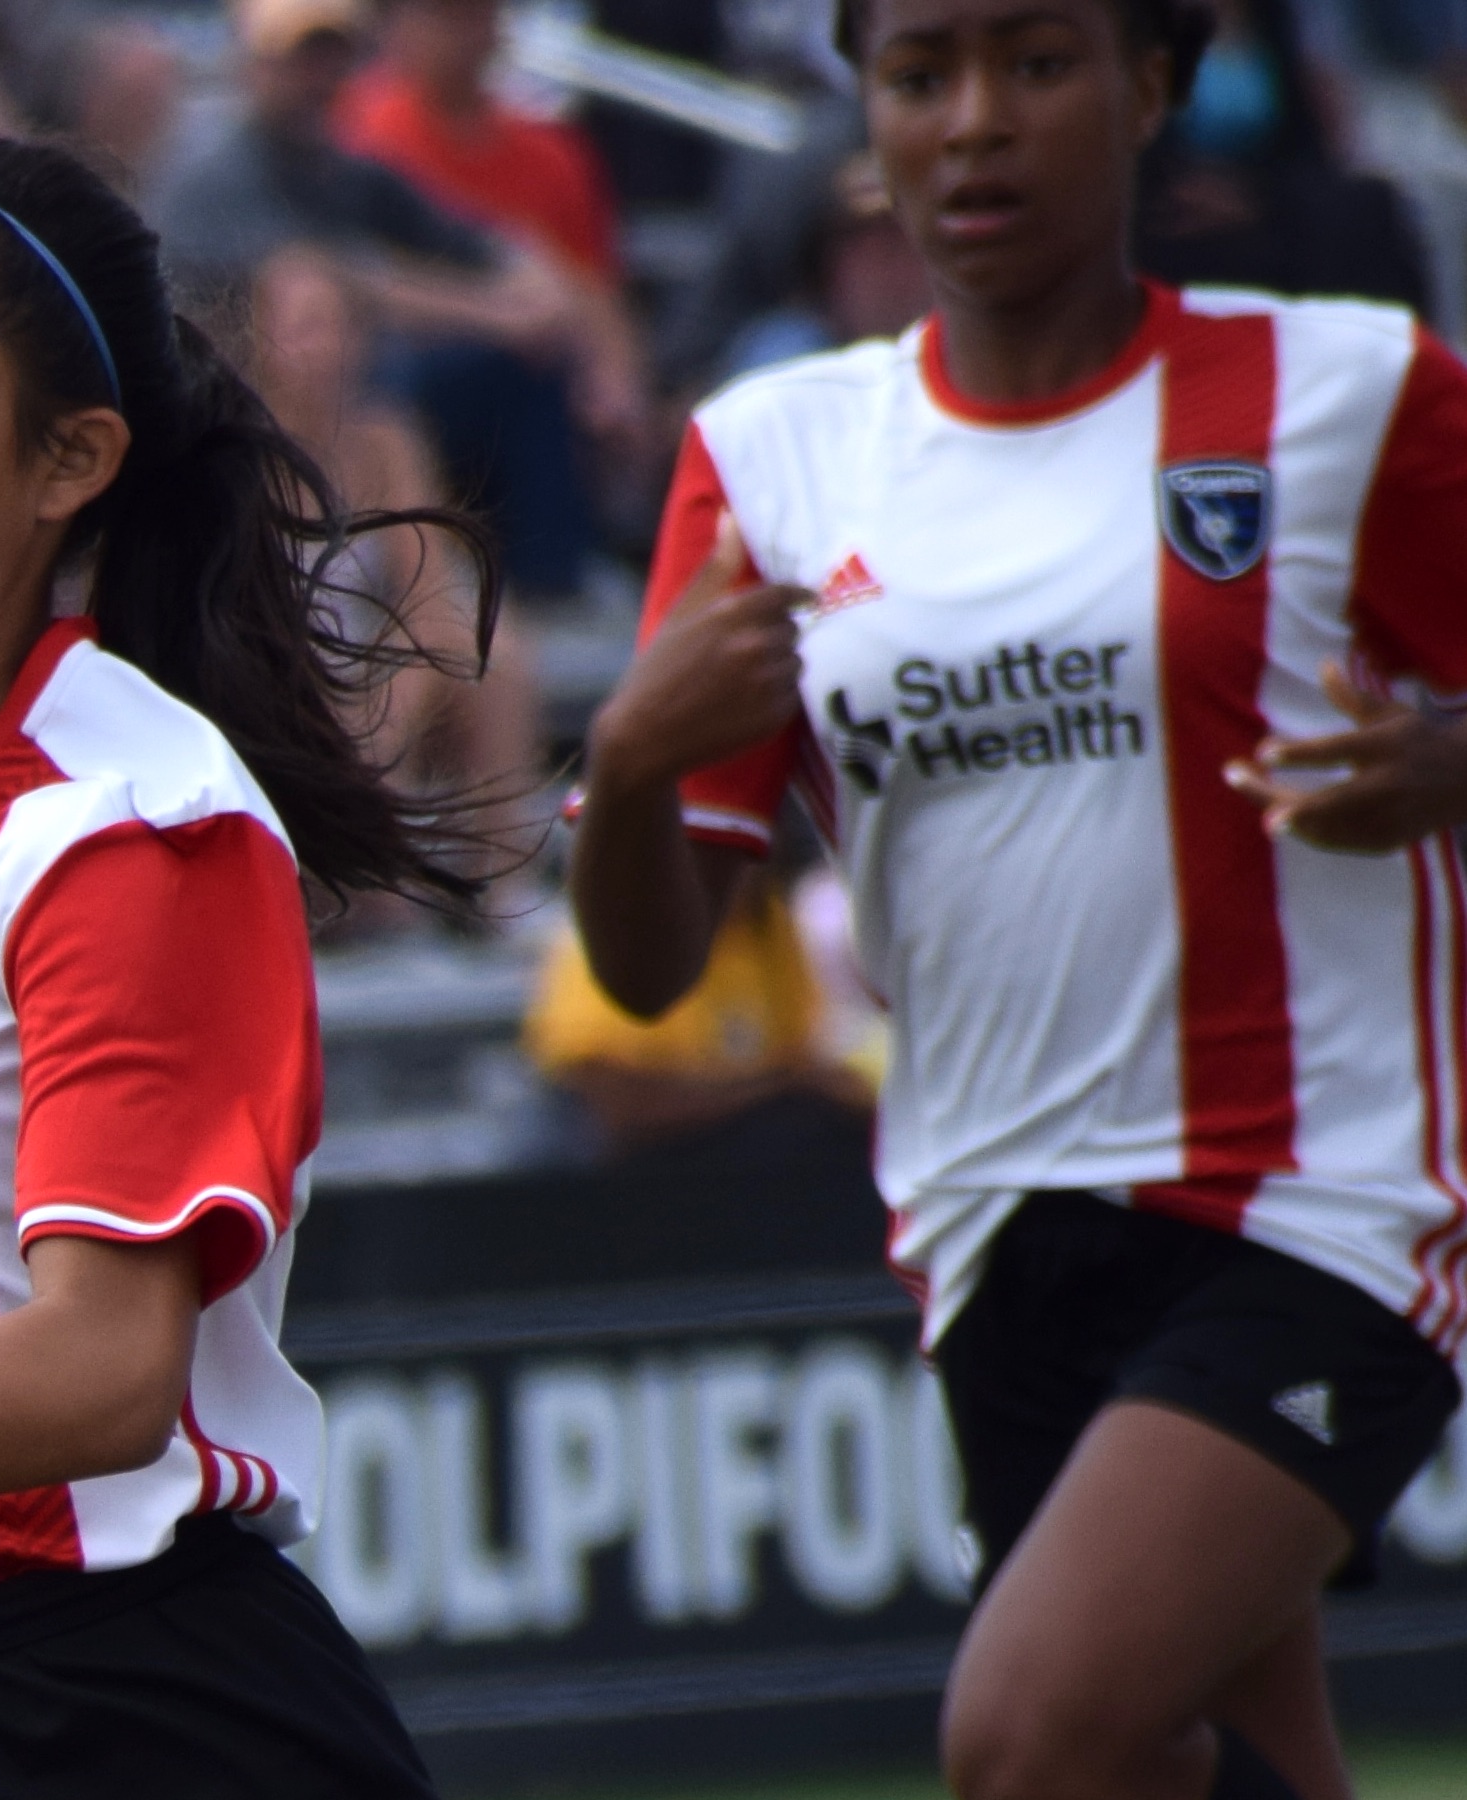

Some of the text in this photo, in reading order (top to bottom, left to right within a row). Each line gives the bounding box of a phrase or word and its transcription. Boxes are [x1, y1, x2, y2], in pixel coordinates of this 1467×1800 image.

[893, 640, 1128, 718] Sutter
[906, 701, 1145, 779] Health
[300, 1337, 975, 1645] OLPIFO
